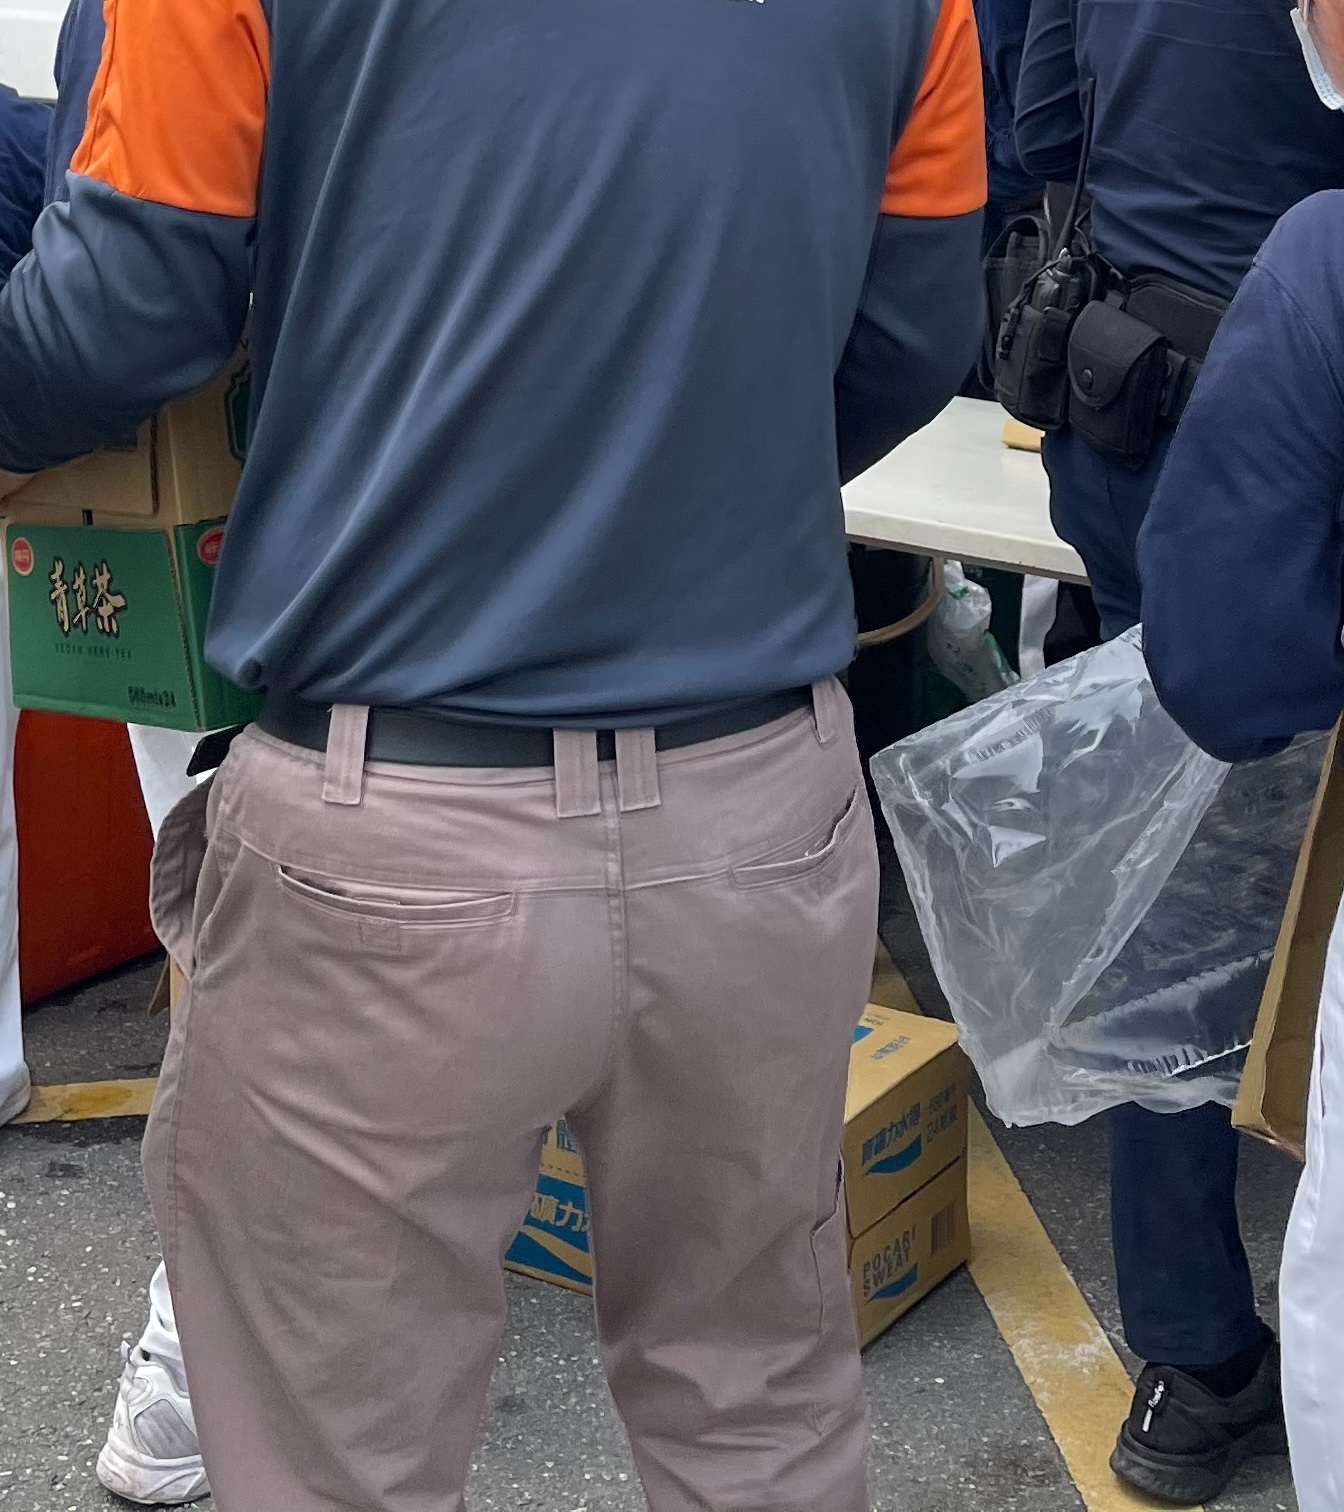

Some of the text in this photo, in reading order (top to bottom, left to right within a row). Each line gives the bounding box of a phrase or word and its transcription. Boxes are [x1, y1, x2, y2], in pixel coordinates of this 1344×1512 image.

[50, 558, 127, 637] 青草茶
[863, 1224, 917, 1273] POCARI
[863, 1247, 911, 1298] SWEAT
